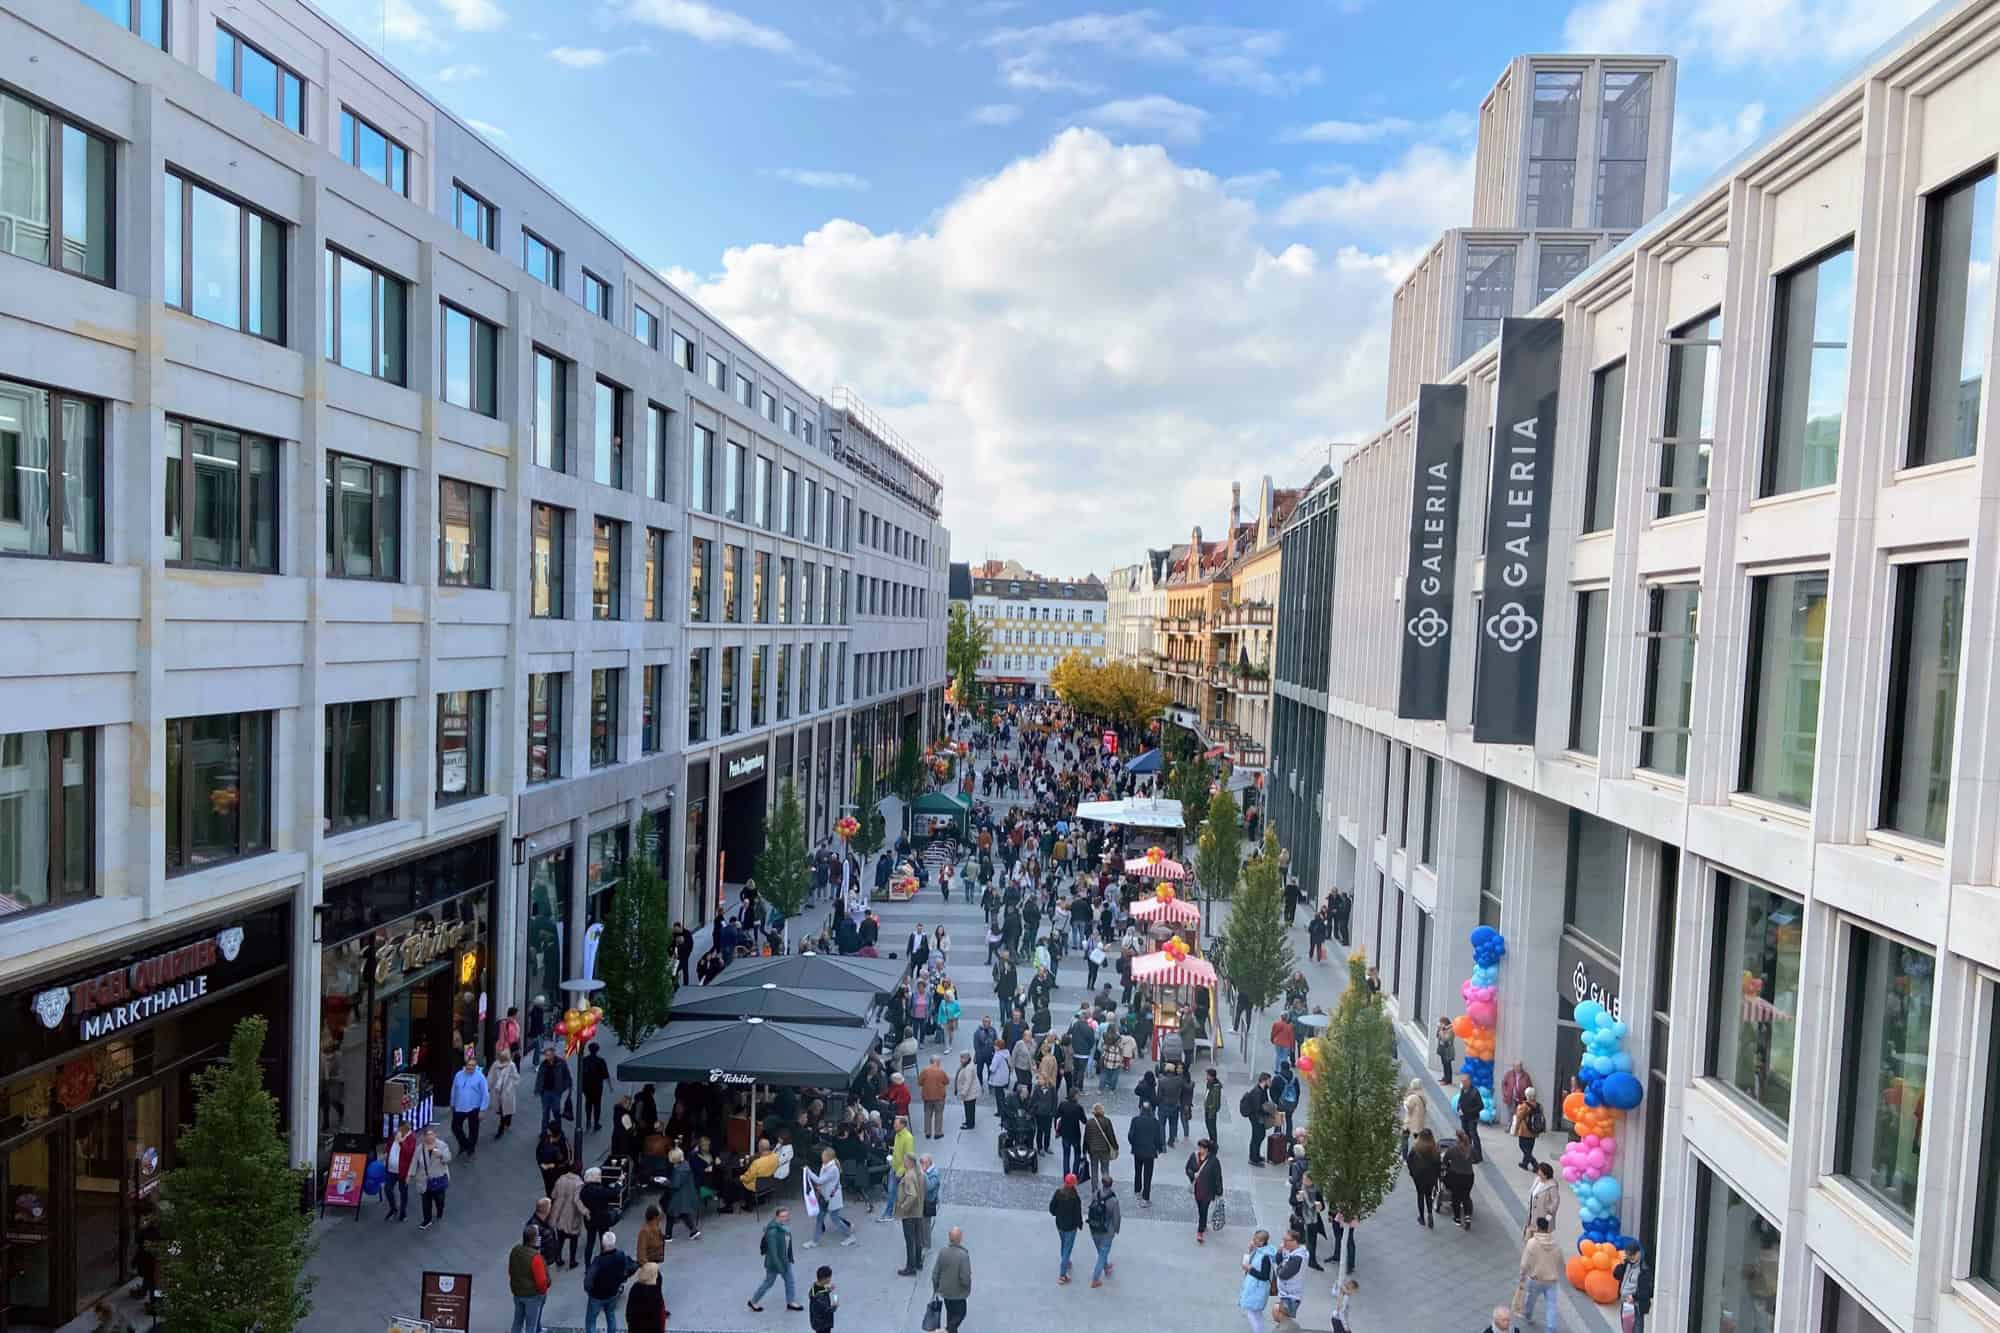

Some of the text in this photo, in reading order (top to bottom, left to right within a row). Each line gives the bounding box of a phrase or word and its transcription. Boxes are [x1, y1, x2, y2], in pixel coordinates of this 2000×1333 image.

[1420, 461, 1449, 596] GALERIA
[1503, 416, 1539, 588] GALERIA
[74, 966, 130, 1017] TEGEL
[80, 975, 208, 1041] MARKTHALLE
[722, 1073, 757, 1084] Tchibo
